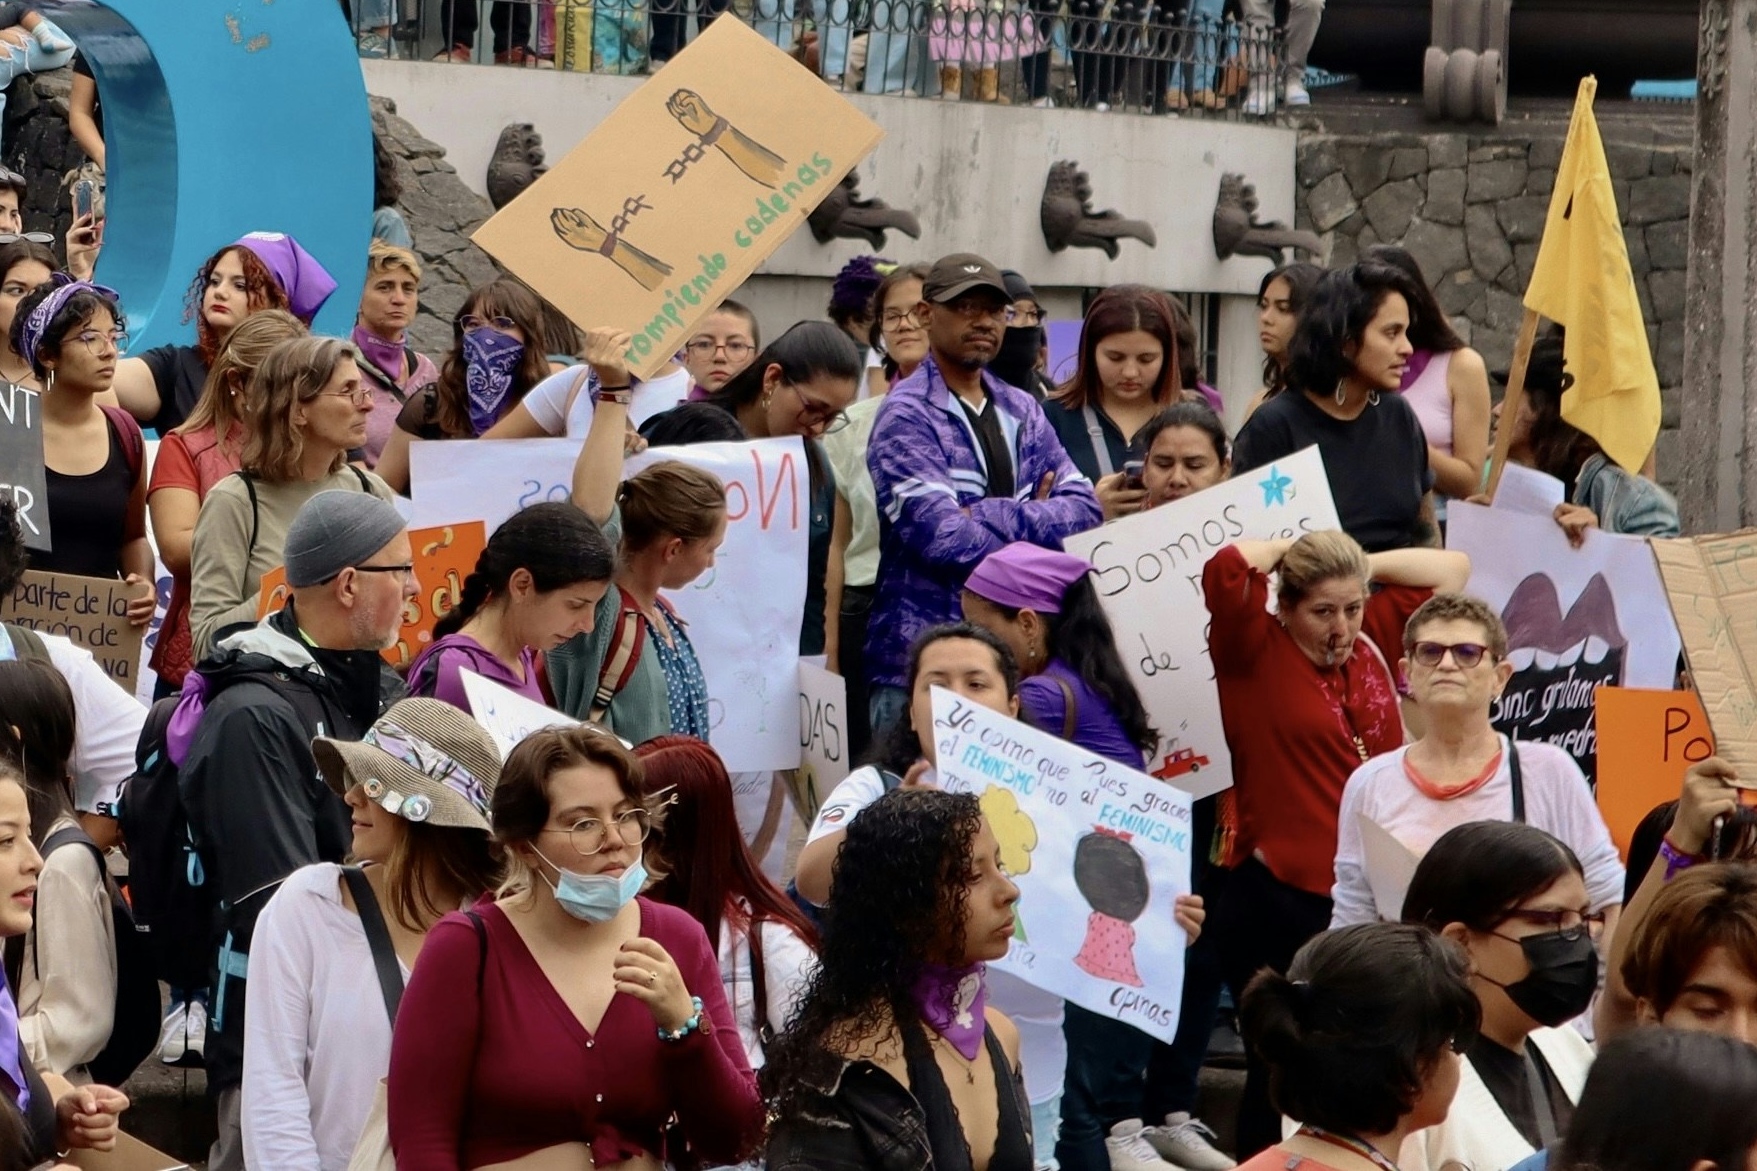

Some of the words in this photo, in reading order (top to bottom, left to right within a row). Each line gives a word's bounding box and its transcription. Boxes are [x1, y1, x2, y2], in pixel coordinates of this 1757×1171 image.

[624, 251, 727, 365] rompiendo
[734, 150, 833, 249] cadenas
[1089, 504, 1244, 597] Somos
[13, 577, 71, 613] parte
[74, 584, 100, 615] de
[107, 586, 129, 617] la
[88, 622, 119, 647] de
[1139, 632, 1181, 677] de
[800, 692, 841, 763] DAS
[934, 700, 977, 736] Yo
[980, 727, 1035, 765] opino
[1037, 756, 1071, 790] que
[1663, 707, 1713, 763] Po
[939, 735, 961, 759] el
[1046, 786, 1068, 807] no
[1082, 759, 1129, 798] Pues
[1081, 788, 1100, 806] al
[1110, 985, 1174, 1028] opinas
